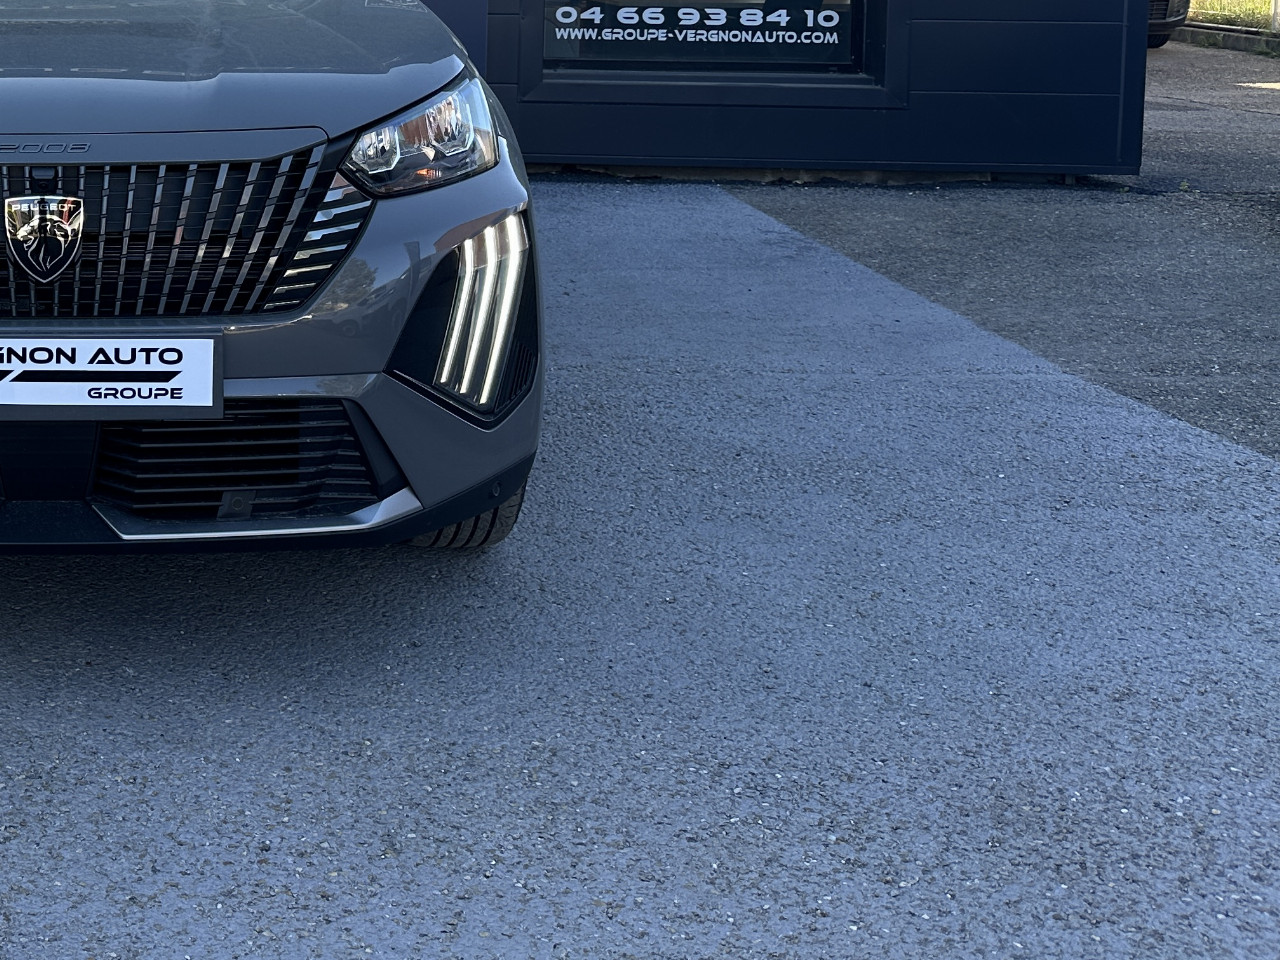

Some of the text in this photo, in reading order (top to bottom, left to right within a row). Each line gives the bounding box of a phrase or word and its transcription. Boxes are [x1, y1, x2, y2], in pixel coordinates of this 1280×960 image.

[555, 6, 840, 27] 04 66 93 84 10
[554, 27, 839, 44] WWW.GROUPE-VERGNONAUTO.COM
[11, 203, 77, 212] PEUGEOT
[86, 346, 184, 366] AUTO
[87, 387, 184, 400] GROUPE
